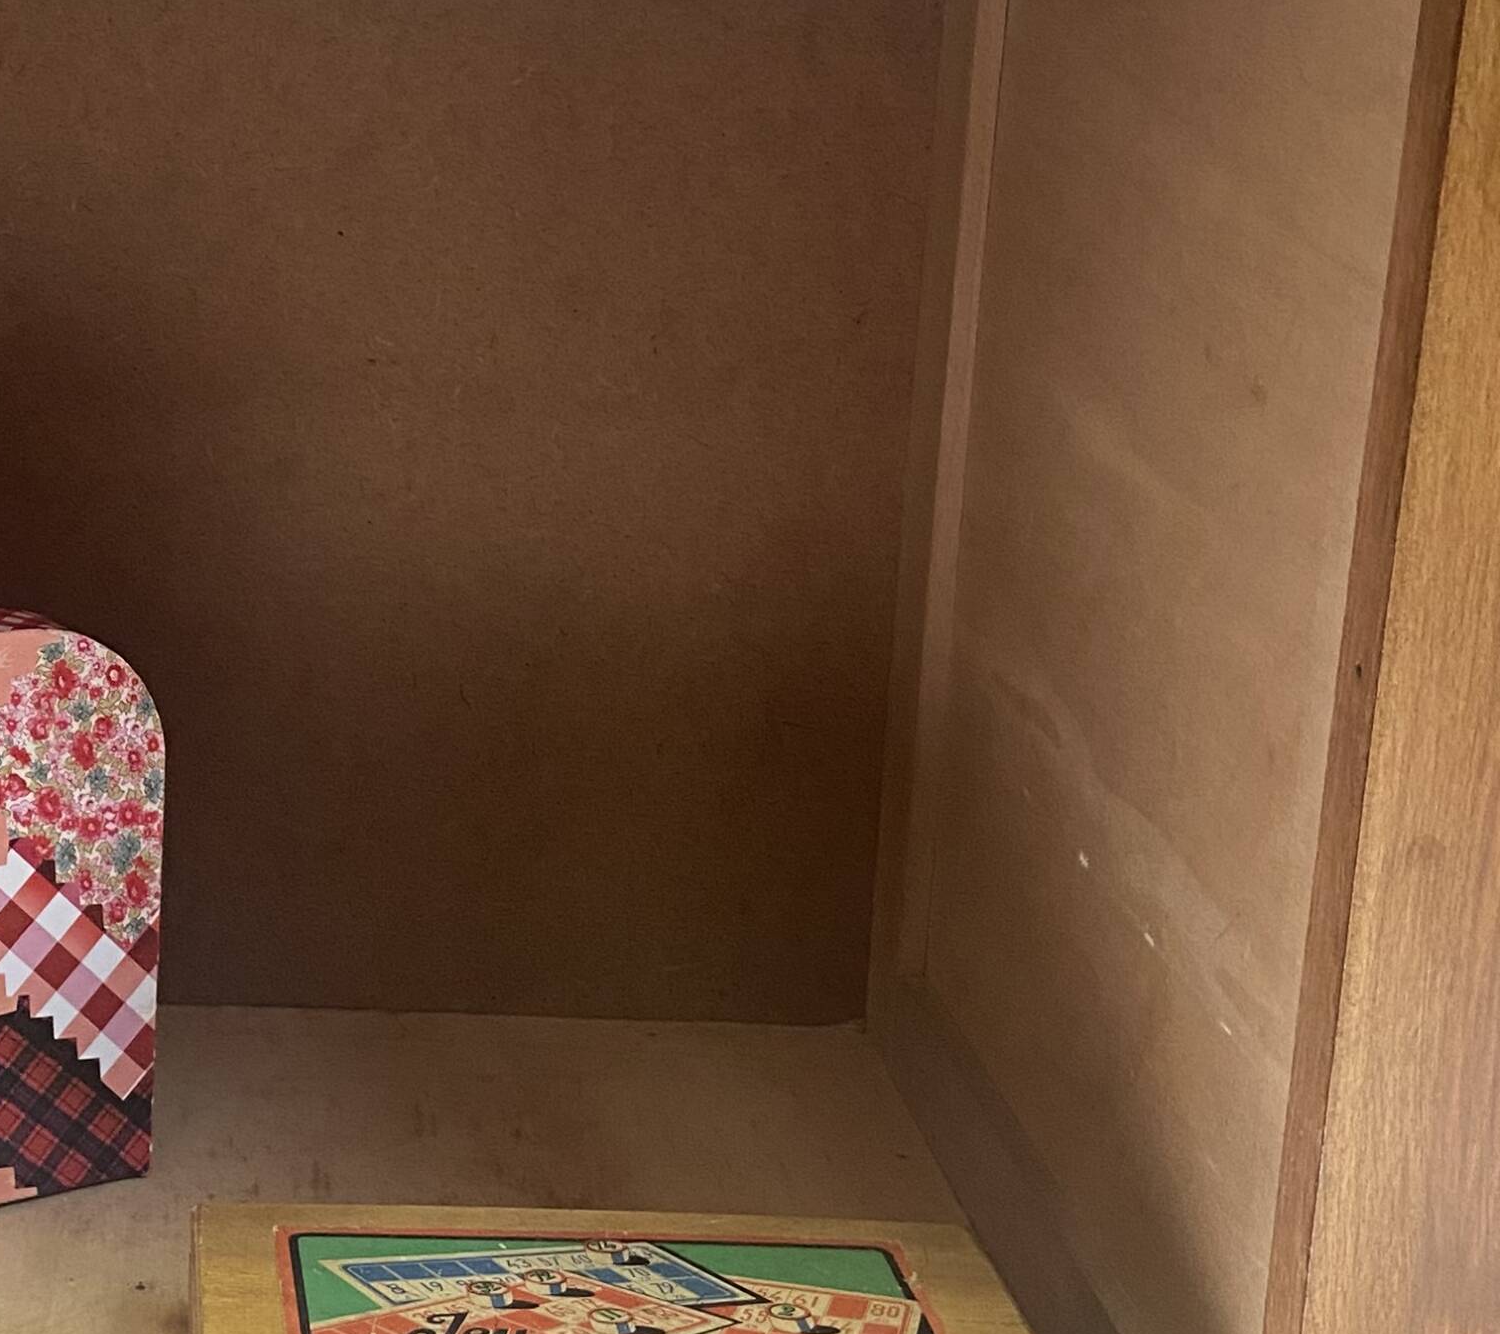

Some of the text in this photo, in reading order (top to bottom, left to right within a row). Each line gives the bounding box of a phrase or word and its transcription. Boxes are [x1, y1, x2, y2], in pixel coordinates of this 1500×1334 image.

[386, 1283, 407, 1295] 8
[419, 1280, 444, 1293] 19
[870, 1303, 902, 1319] 80
